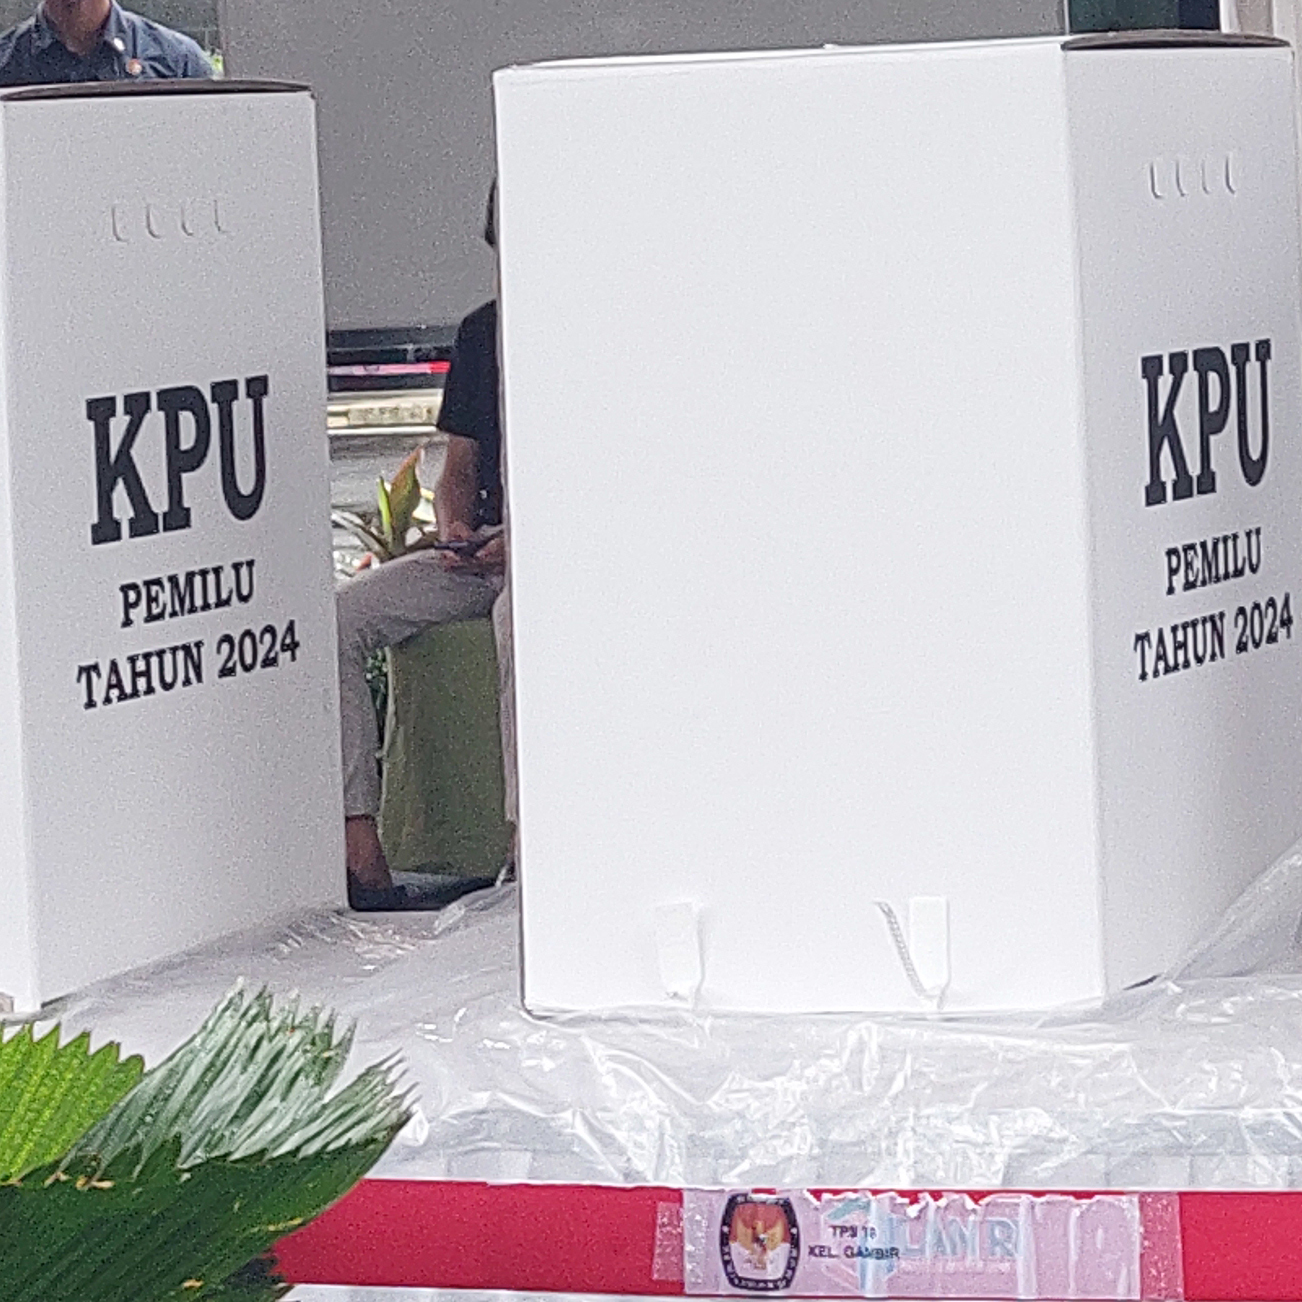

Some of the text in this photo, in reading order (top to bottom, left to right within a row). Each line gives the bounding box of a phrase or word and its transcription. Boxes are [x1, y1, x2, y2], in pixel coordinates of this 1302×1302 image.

[85, 374, 269, 546] KPU
[1141, 337, 1272, 507] KPU
[119, 558, 256, 629] PEMILU
[1165, 526, 1262, 596] PEMILU
[76, 618, 300, 710] TAHUN 2024
[1133, 592, 1293, 682] TAHUN 2024
